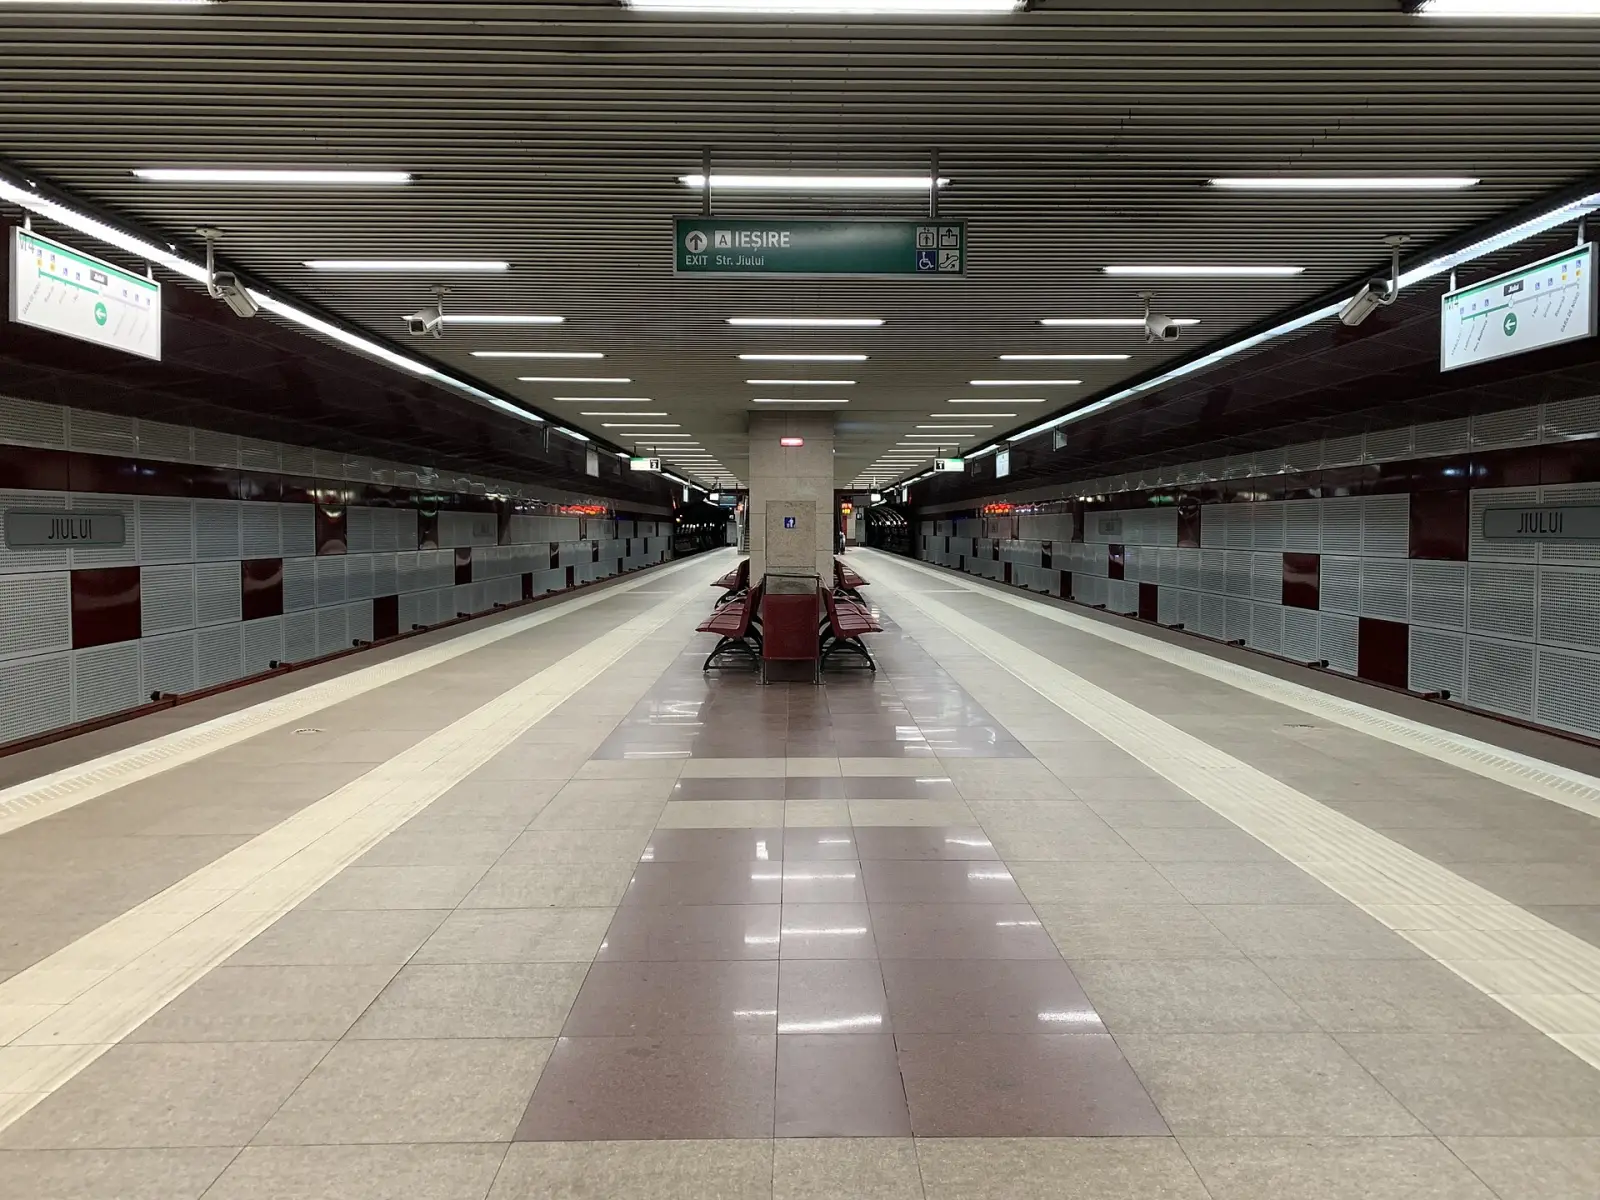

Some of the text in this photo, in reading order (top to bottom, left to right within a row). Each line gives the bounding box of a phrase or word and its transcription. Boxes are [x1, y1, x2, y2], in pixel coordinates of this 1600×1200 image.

[718, 233, 729, 246] A
[685, 255, 708, 265] EXIT
[716, 255, 765, 266] Str. Jiului
[48, 518, 92, 540] JIULUI
[1517, 512, 1563, 533] JIULUI
